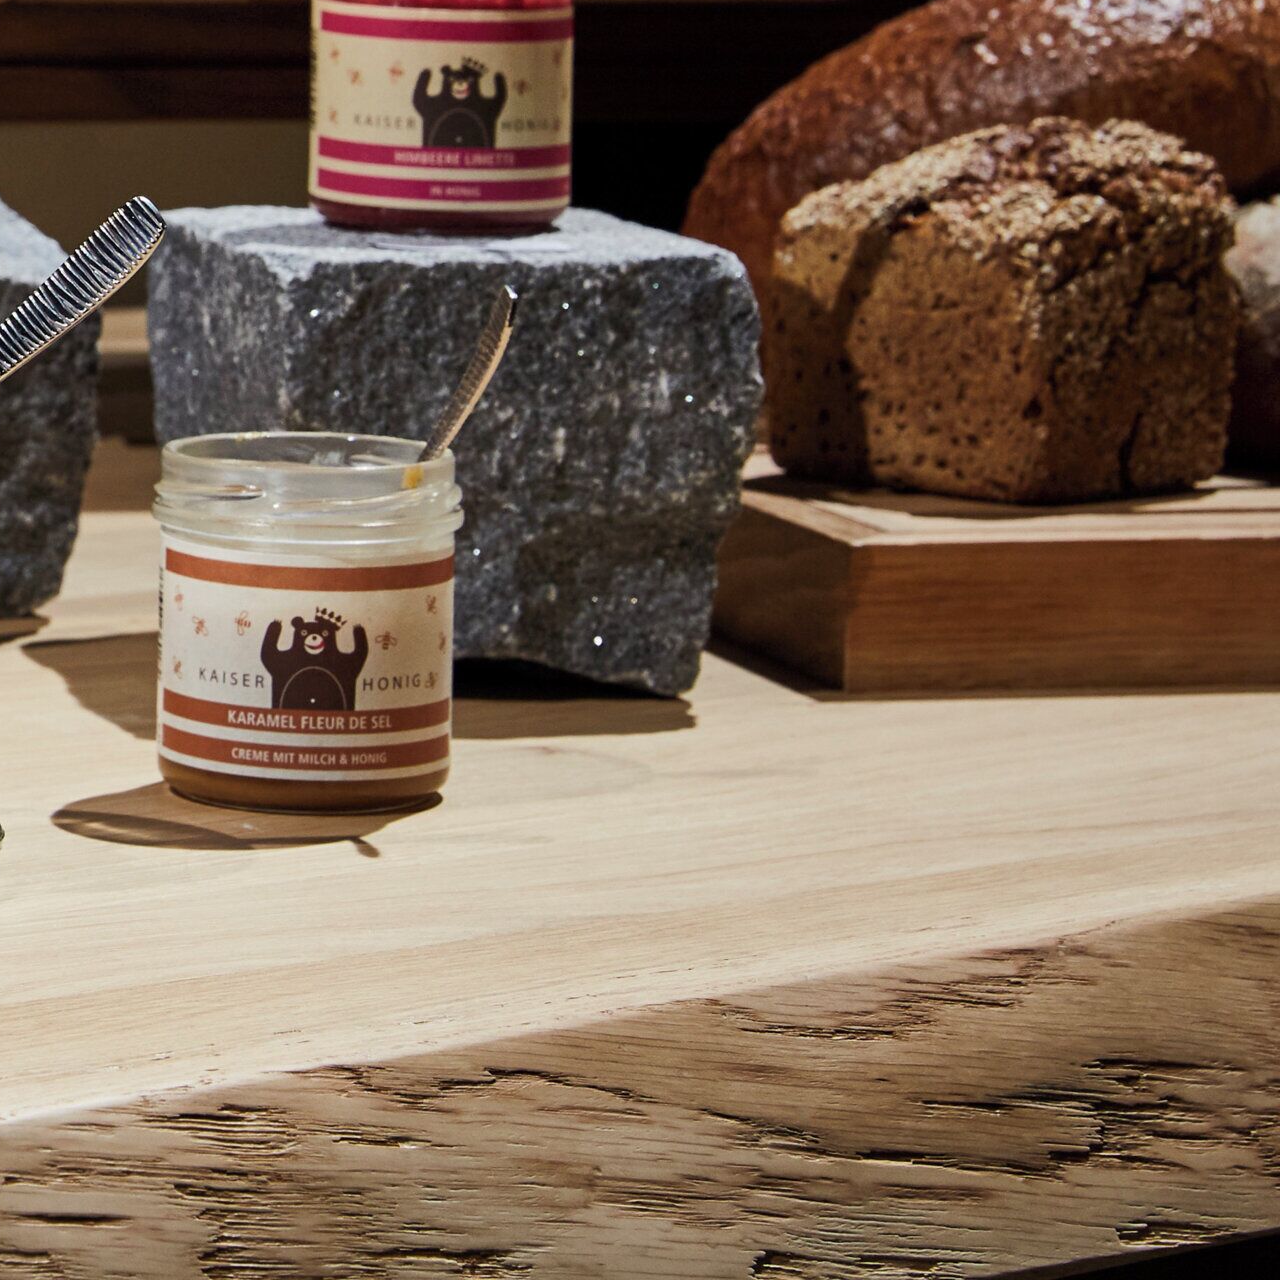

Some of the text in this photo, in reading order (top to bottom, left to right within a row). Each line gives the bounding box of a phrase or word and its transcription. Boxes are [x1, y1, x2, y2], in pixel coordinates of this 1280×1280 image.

[198, 667, 422, 693] KAISER HONIG
[227, 709, 392, 731] KARAMEL FLEUR DE SEL
[231, 747, 388, 766] CREME MIT MILCH & HONIG
